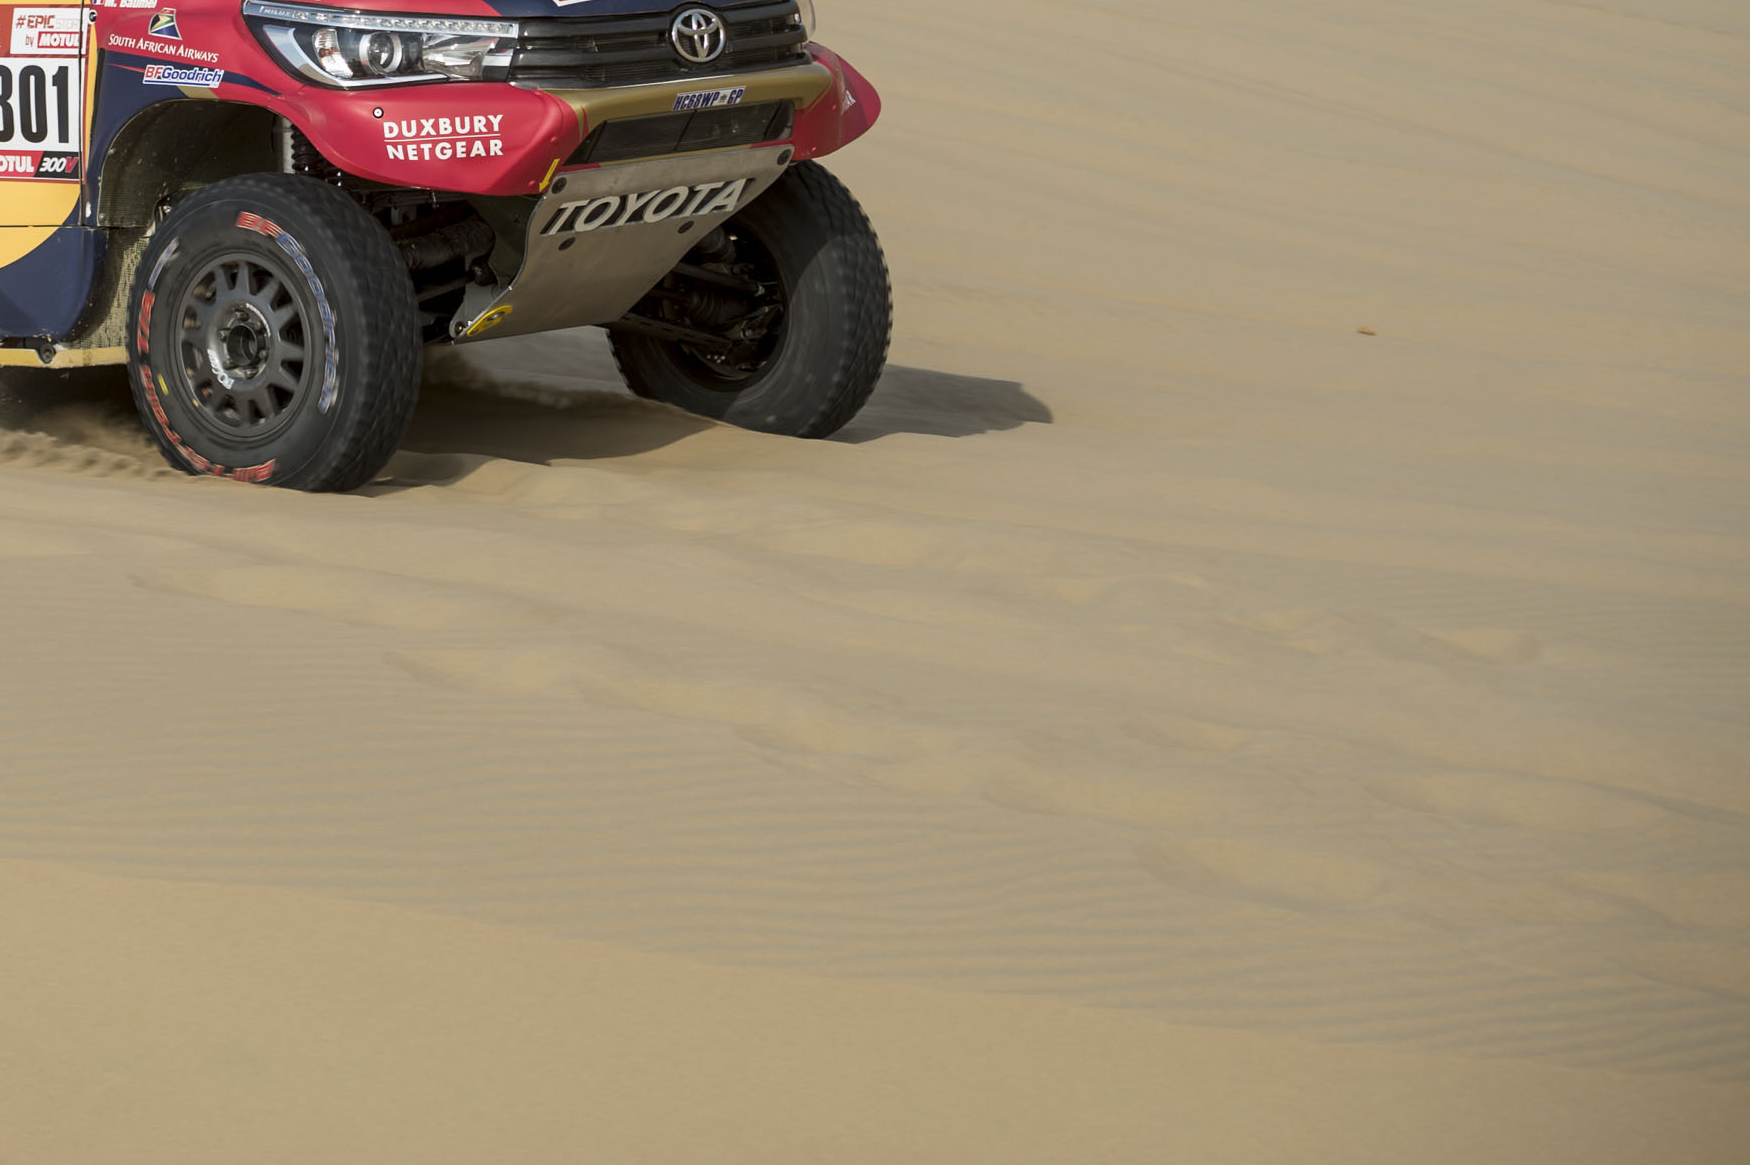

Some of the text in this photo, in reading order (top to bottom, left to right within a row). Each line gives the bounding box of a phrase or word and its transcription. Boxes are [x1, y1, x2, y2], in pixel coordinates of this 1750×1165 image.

[38, 33, 81, 47] MOTUL
[108, 34, 219, 63] SOUTH AFRICAN AIRWAYS
[146, 65, 223, 83] BFGoodrich
[383, 115, 504, 138] DUXBURY
[386, 139, 504, 161] NETGEAR
[39, 157, 78, 173] 300V
[547, 179, 750, 236] TOYOTA
